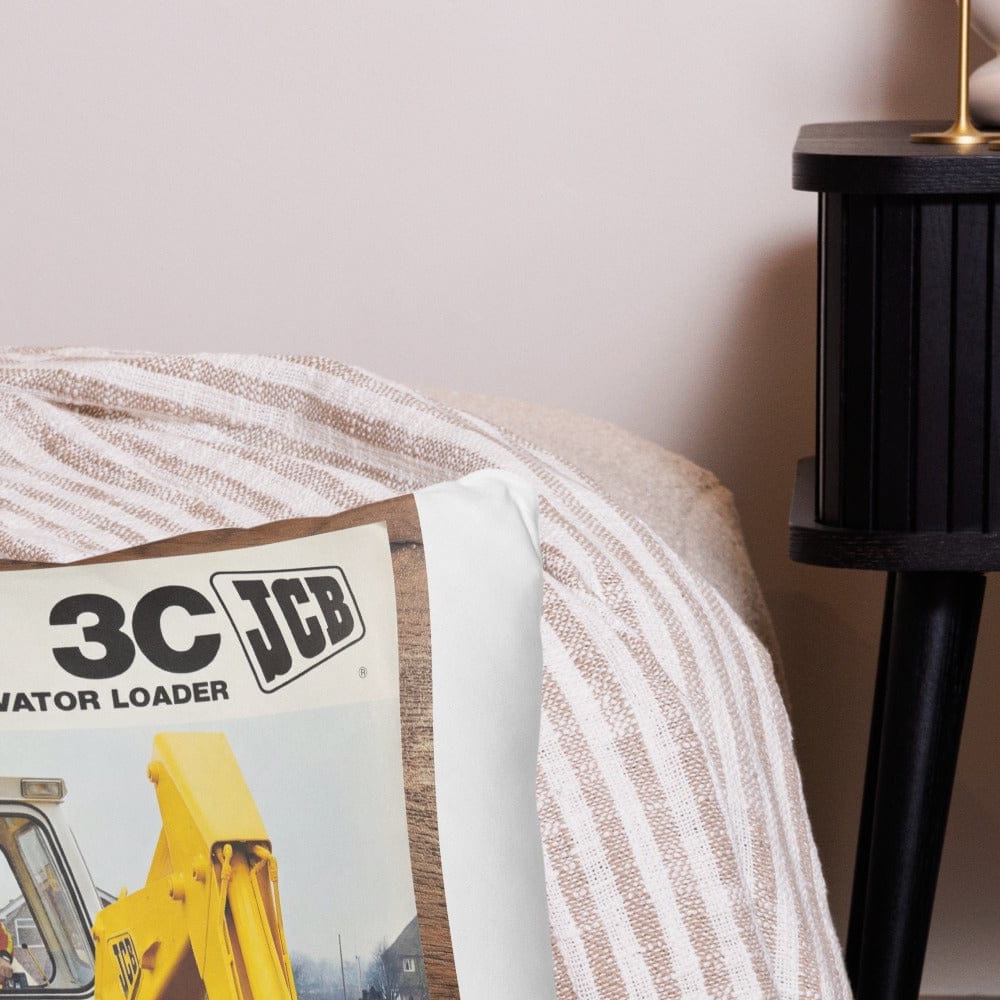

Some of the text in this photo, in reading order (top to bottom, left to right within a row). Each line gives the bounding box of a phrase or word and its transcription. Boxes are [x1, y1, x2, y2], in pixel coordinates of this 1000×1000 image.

[49, 585, 222, 681] 3C
[231, 575, 356, 684] JCB
[111, 680, 229, 709] LOADER
[112, 937, 138, 1000] JCB
